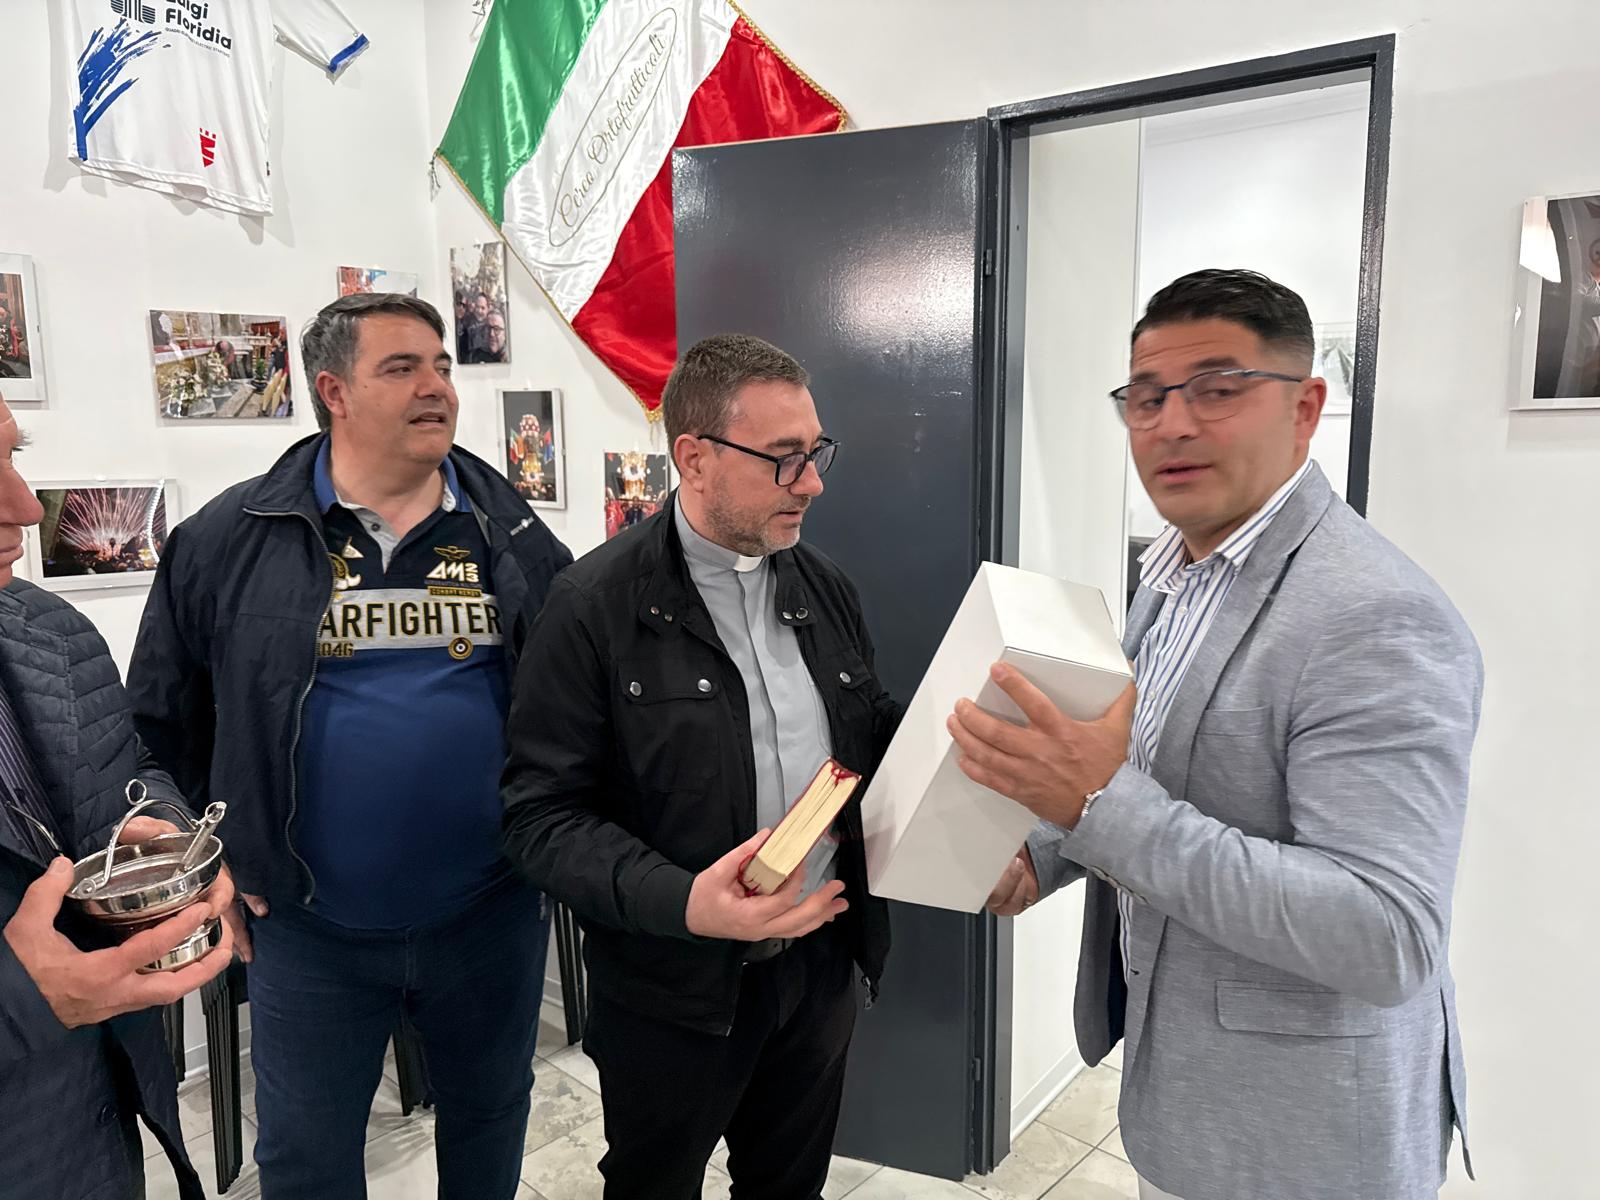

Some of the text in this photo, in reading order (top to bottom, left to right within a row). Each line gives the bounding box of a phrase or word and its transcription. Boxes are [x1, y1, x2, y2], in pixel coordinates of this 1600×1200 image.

[165, 8, 232, 50] Floridia
[166, 0, 209, 20] uigi
[587, 34, 666, 165] Ortofrutticoli
